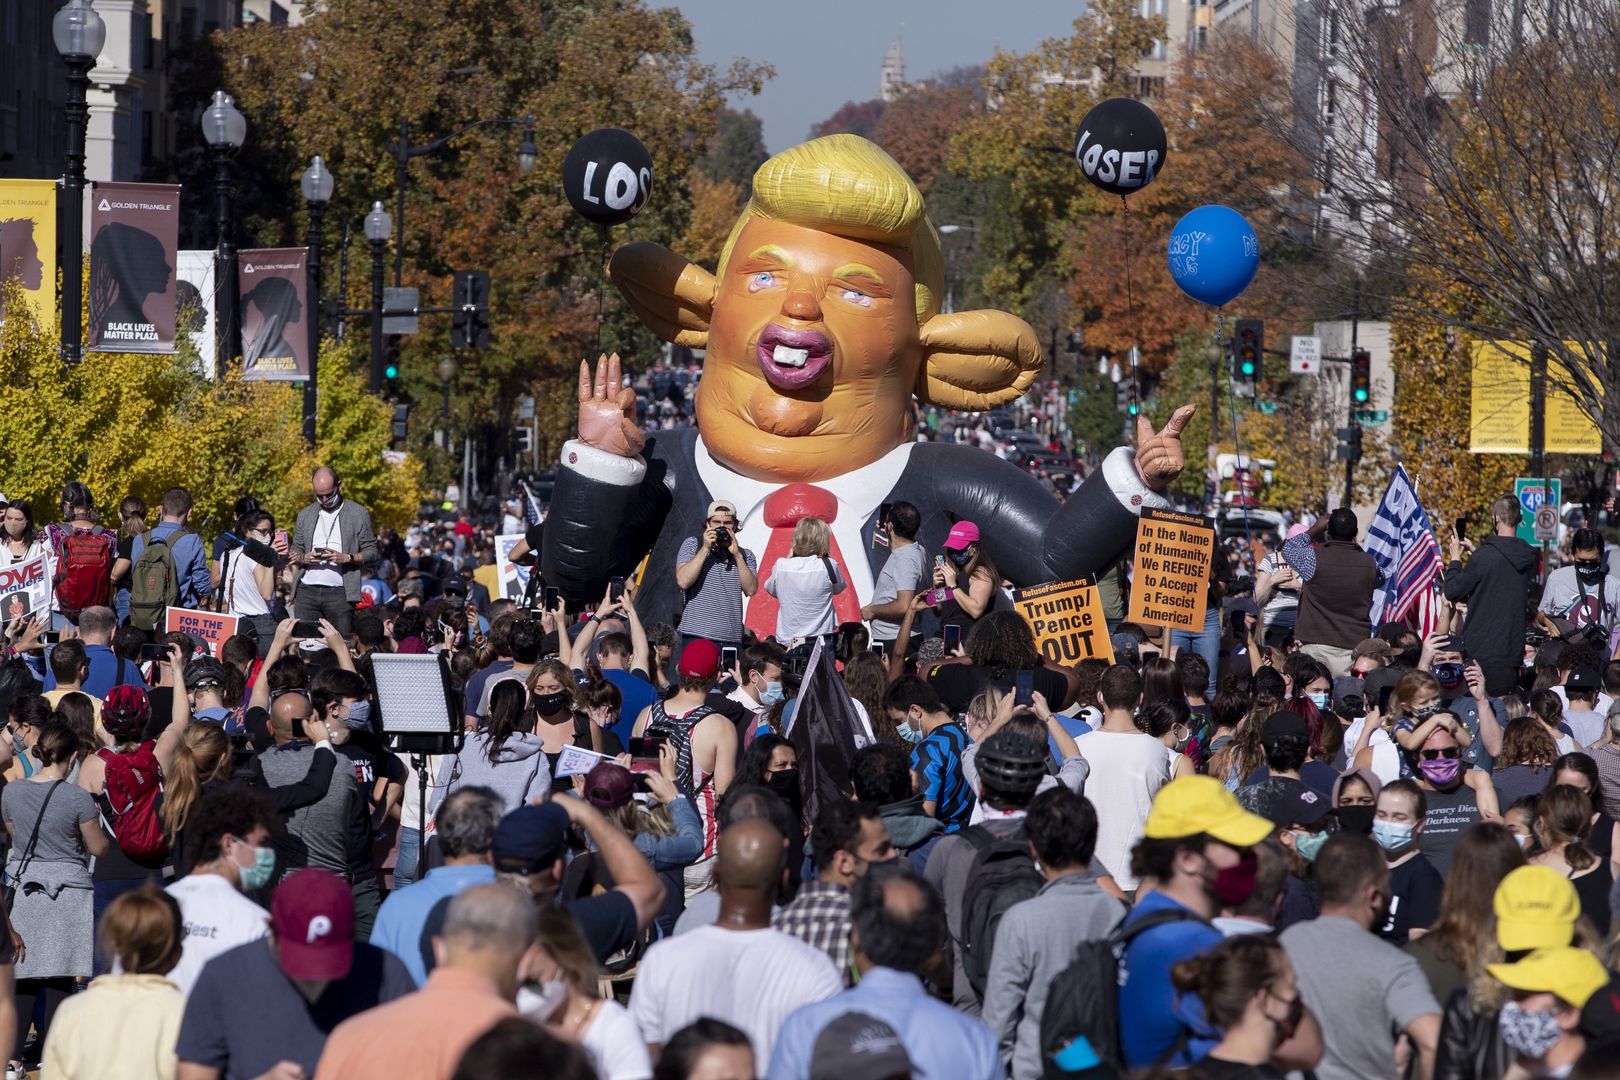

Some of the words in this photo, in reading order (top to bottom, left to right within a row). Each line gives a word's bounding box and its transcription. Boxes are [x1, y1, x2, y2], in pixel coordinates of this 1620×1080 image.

[1076, 130, 1159, 187] LOSER
[583, 161, 655, 214] LOS
[140, 203, 172, 211] TRIANGLE
[103, 331, 134, 340] MATTER
[135, 332, 159, 341] PLAZA
[108, 323, 133, 331] BLACK
[134, 324, 156, 332] LIVES
[1300, 339, 1314, 347] NO
[1525, 492, 1546, 510] 49
[1152, 510, 1204, 526] RefuseFascism.org
[1142, 524, 1153, 537] In
[1157, 527, 1176, 540] the
[1179, 530, 1209, 546] Name
[1139, 541, 1151, 553] of
[1154, 543, 1209, 565] Humanity,
[1141, 557, 1159, 570] We
[1162, 560, 1204, 578] REFUSE
[1021, 578, 1087, 598] RefuseFascism.org
[1144, 574, 1157, 586] to
[1159, 576, 1197, 594] Accept
[1023, 588, 1090, 619] Trump/
[1144, 592, 1151, 602] a
[1155, 592, 1195, 609] Fascist
[180, 616, 199, 627] FOR
[203, 619, 223, 630] THE
[1033, 612, 1093, 637] Pence
[1142, 606, 1193, 625] America!
[179, 626, 220, 641] PEOPLE.
[1041, 629, 1094, 665] OUT
[1425, 816, 1470, 826] Darkness
[306, 914, 333, 945] P
